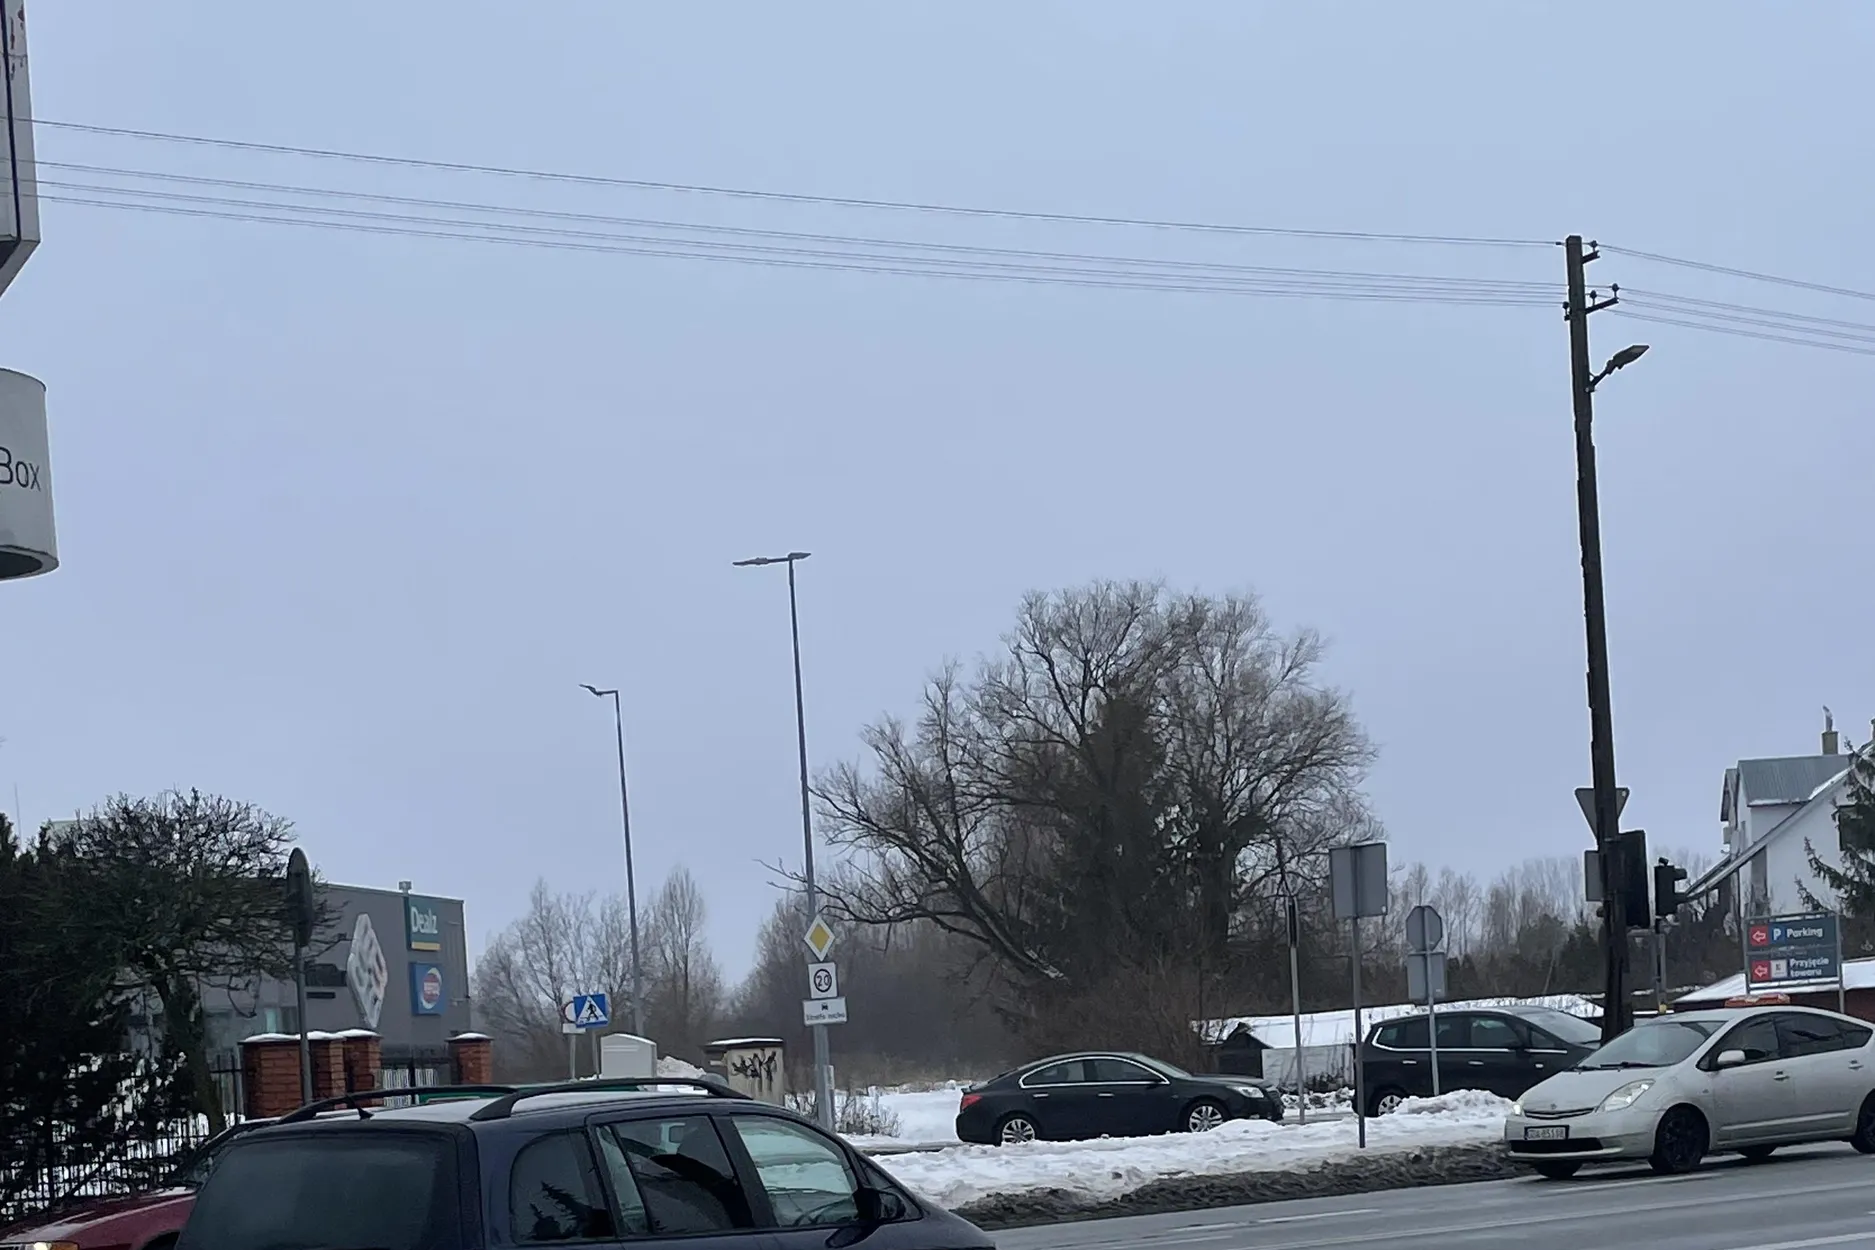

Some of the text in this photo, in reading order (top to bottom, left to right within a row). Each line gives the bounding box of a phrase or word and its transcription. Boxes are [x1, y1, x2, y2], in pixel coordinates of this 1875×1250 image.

[411, 906, 438, 934] Dealz
[1773, 927, 1823, 941] P Parking
[816, 974, 831, 987] 20
